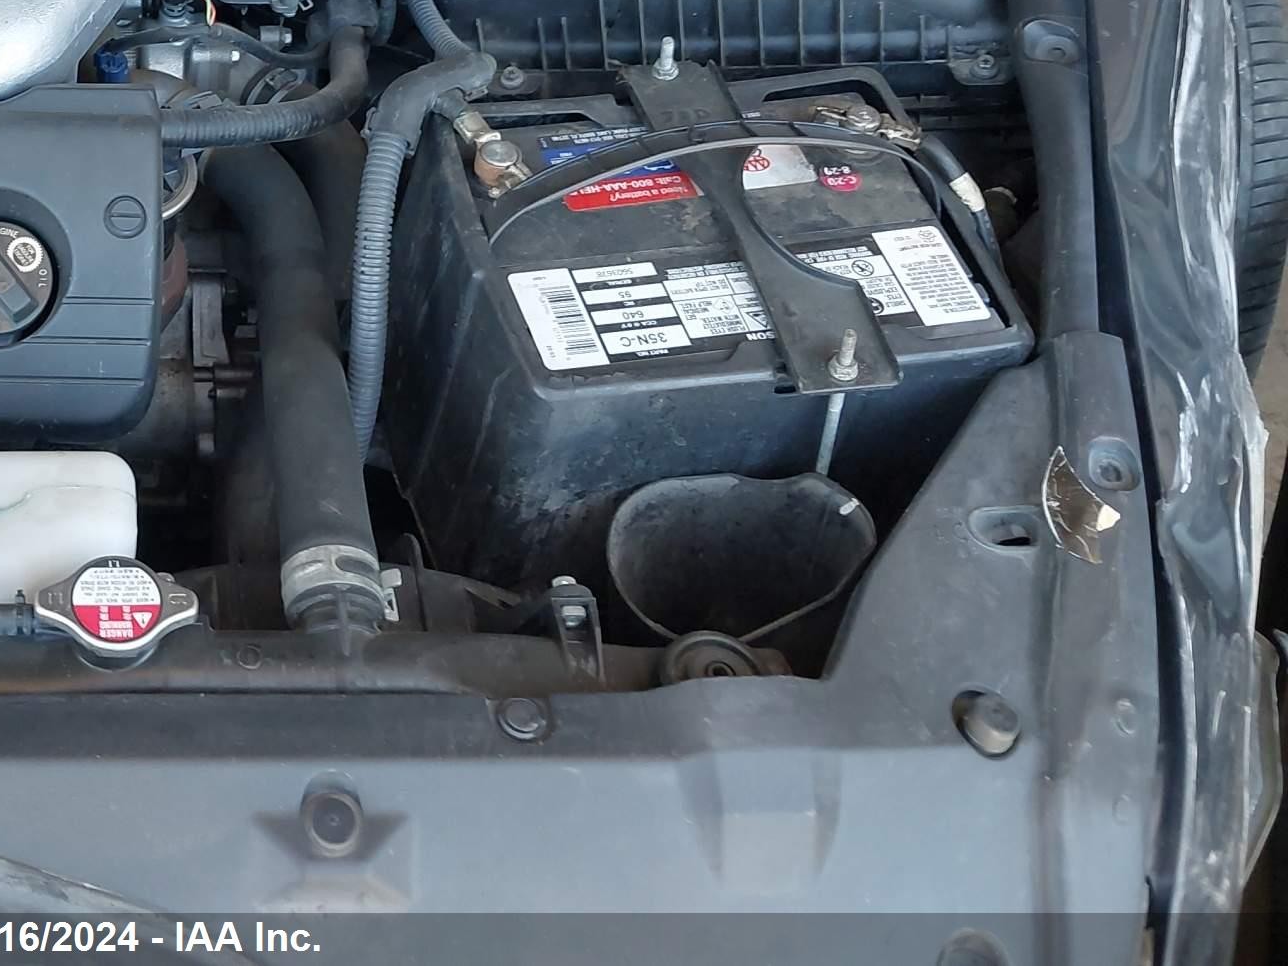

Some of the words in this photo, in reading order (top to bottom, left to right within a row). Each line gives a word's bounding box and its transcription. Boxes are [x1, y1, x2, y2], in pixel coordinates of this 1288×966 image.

[655, 175, 681, 184] Call:
[610, 190, 650, 201] battery?
[38, 268, 48, 287] OIL
[618, 290, 631, 298] 95
[622, 310, 644, 319] 640
[619, 332, 668, 347] 35N-C
